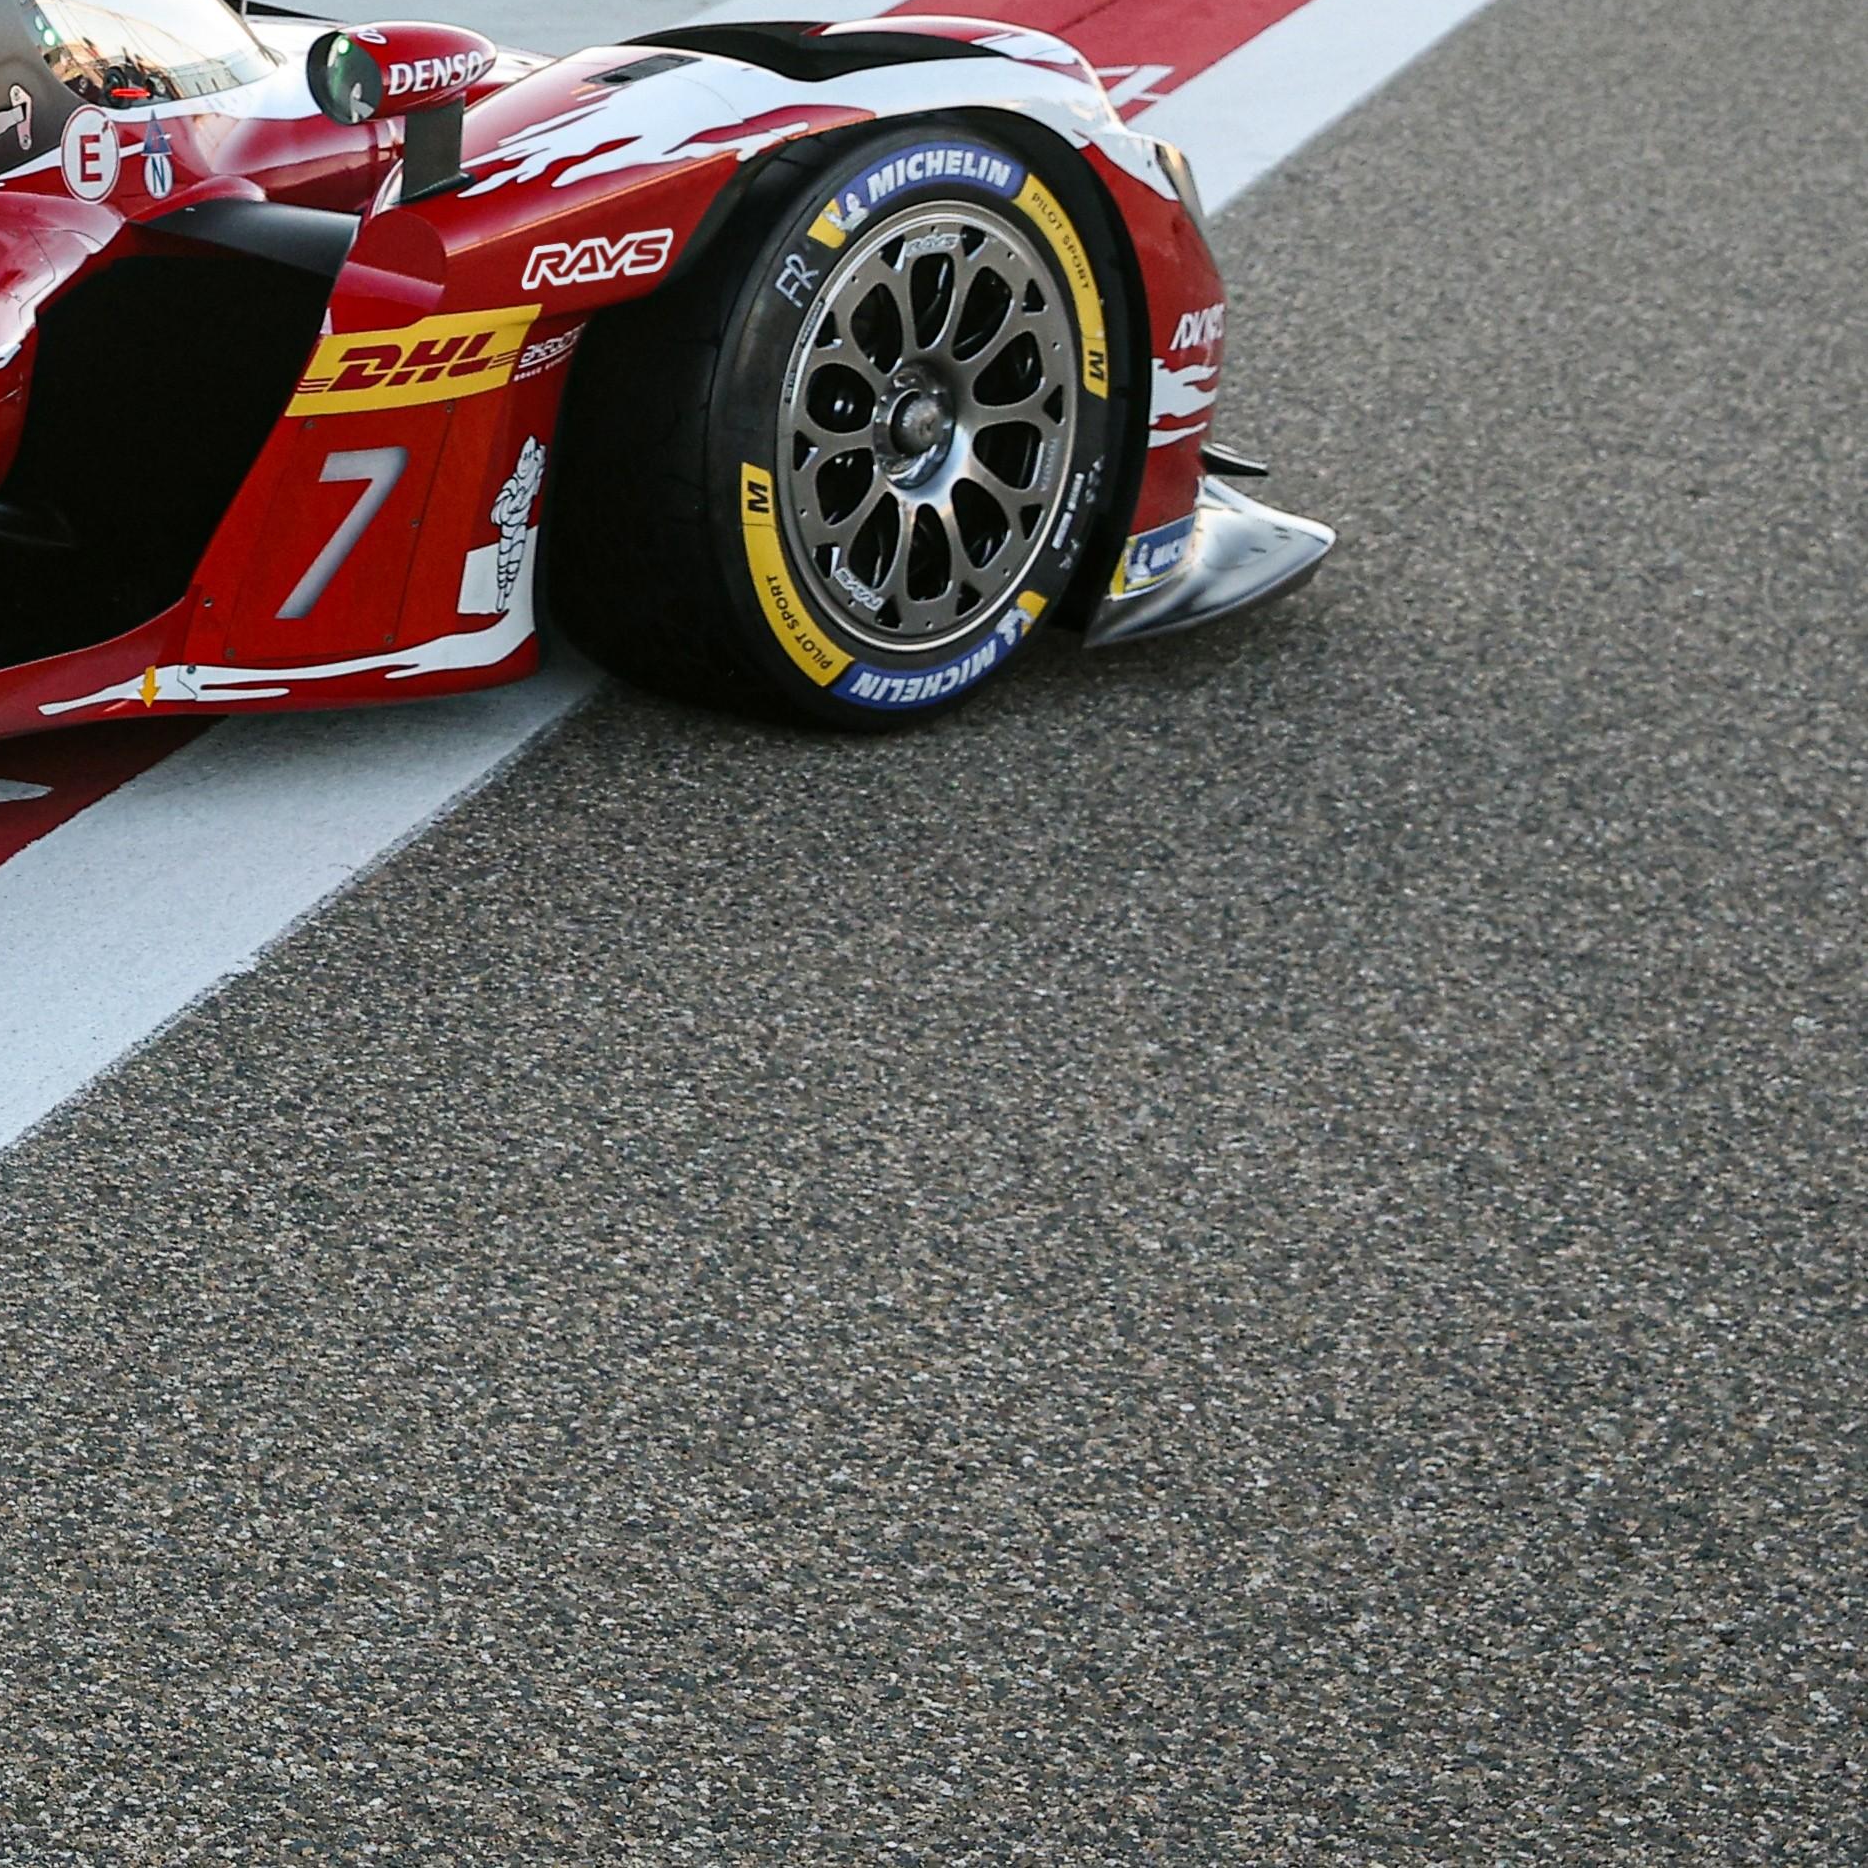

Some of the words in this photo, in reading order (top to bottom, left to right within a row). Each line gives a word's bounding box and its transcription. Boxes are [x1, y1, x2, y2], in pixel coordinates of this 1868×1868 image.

[388, 51, 484, 96] DENSO
[80, 134, 102, 183] E
[152, 155, 165, 194] N
[866, 148, 1011, 205] MICHELIN
[523, 230, 673, 289] RAYS
[1031, 192, 1063, 231] PILOT
[1062, 235, 1090, 289] SPORT
[775, 254, 819, 308] FR
[326, 331, 497, 393] DHL
[1087, 350, 1105, 381] M
[748, 481, 770, 514] M
[274, 446, 409, 620] 7
[766, 575, 800, 630] SPORT
[795, 633, 833, 670] PILOT
[849, 639, 997, 703] MICHELIN
